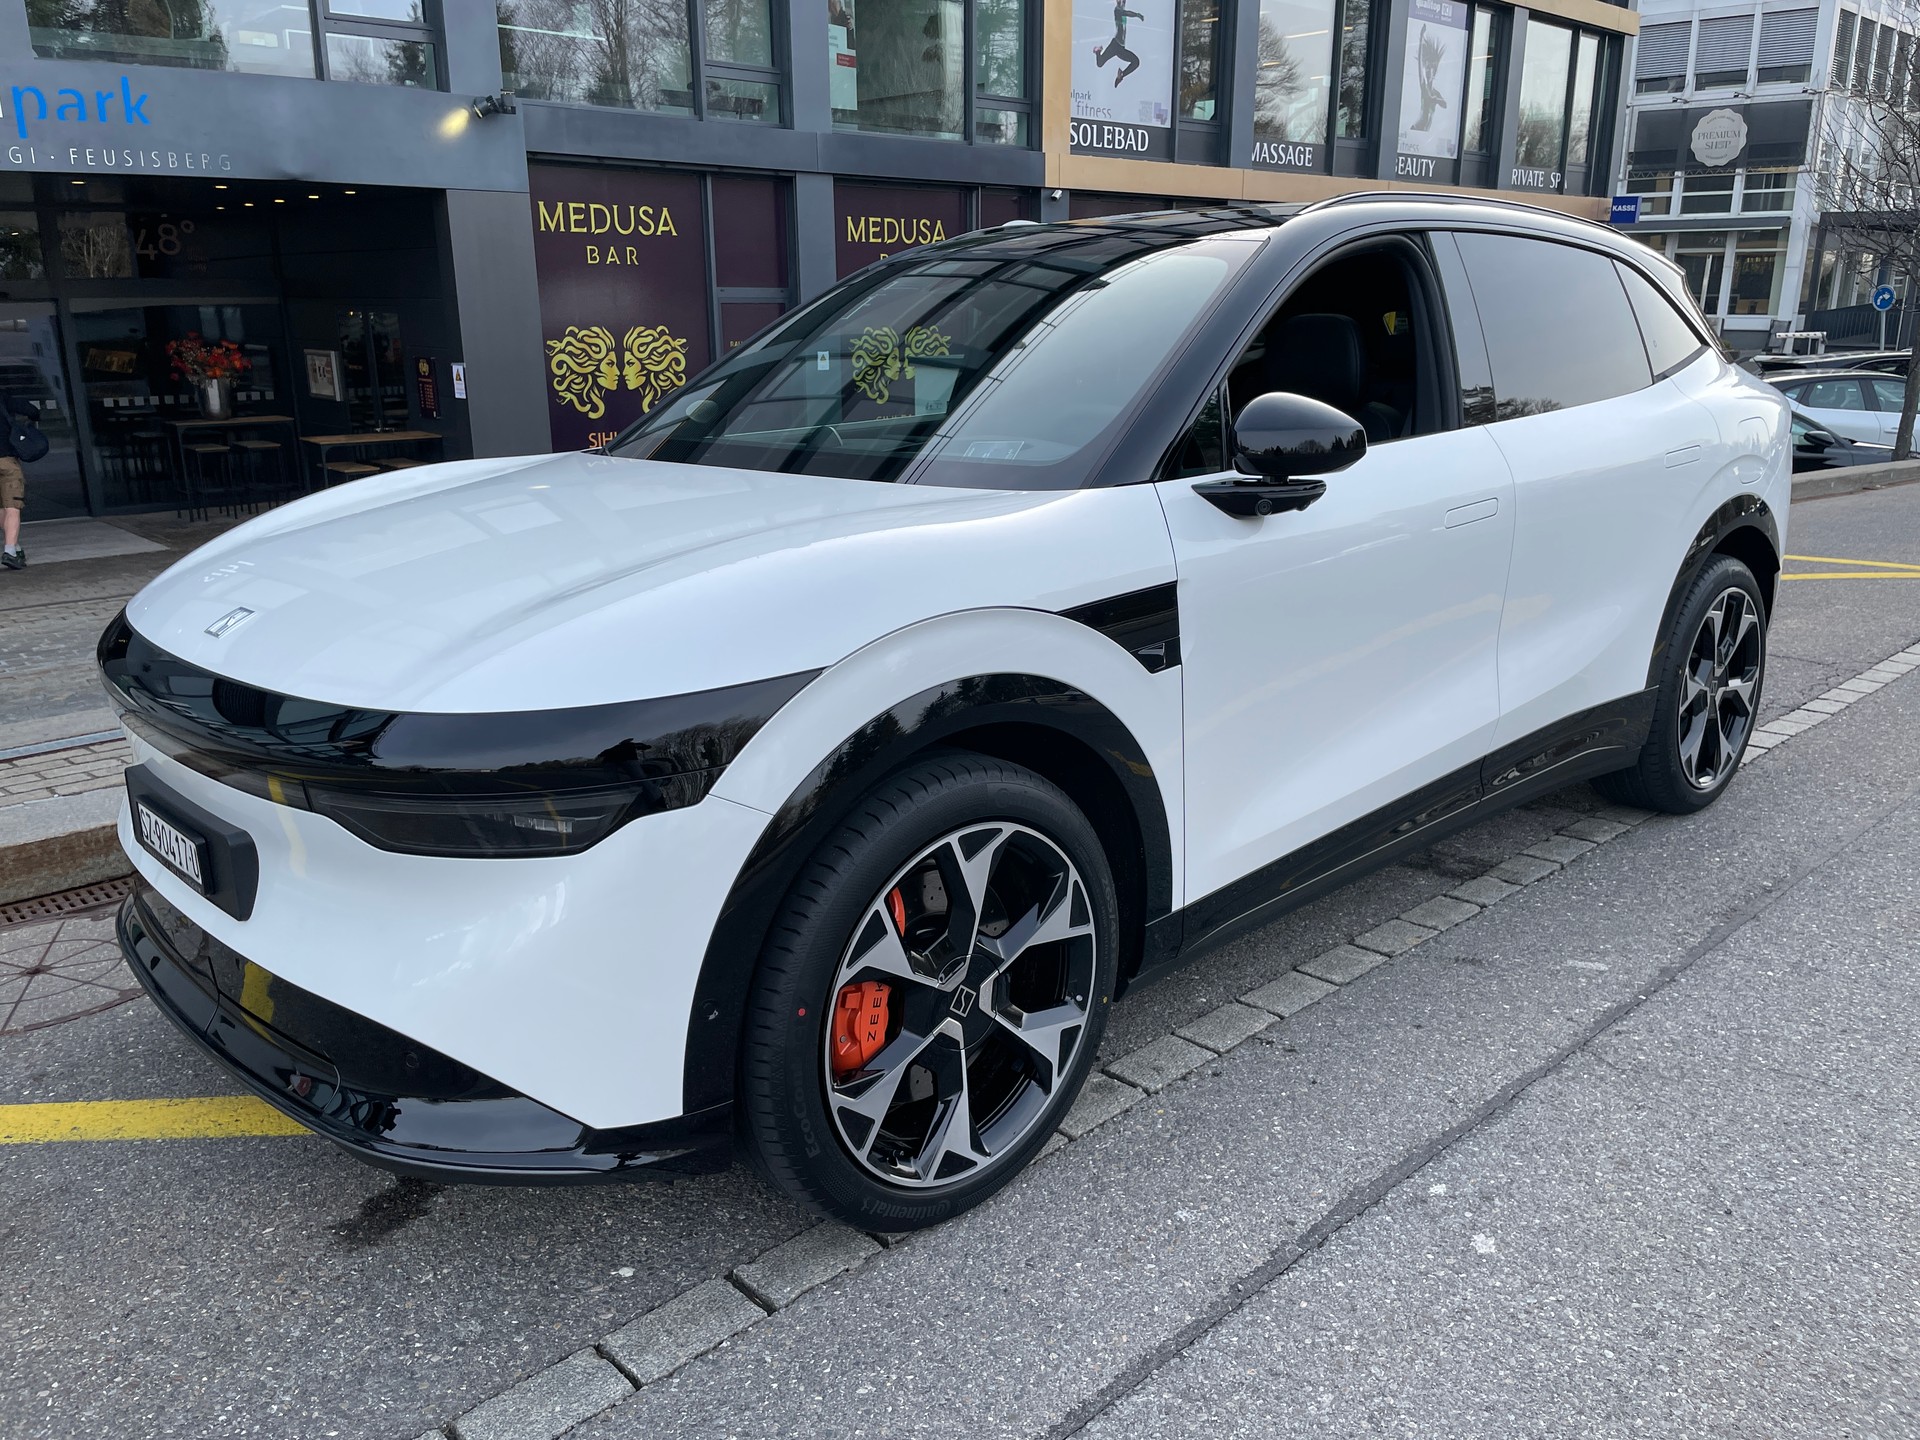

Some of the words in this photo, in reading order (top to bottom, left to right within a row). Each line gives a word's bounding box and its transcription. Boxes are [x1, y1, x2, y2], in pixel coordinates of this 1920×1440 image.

[1076, 100, 1112, 119] fitness
[1070, 122, 1149, 152] SOLEBAD
[1697, 130, 1741, 141] PREMIUM
[69, 148, 232, 171] FEUSISBERG
[1394, 156, 1436, 178] EAUTY
[1511, 168, 1545, 188] RIVATE
[537, 200, 678, 237] MEDUSA
[1612, 204, 1636, 212] KASSE
[846, 215, 946, 245] MEDUSA
[586, 245, 639, 266] BAR
